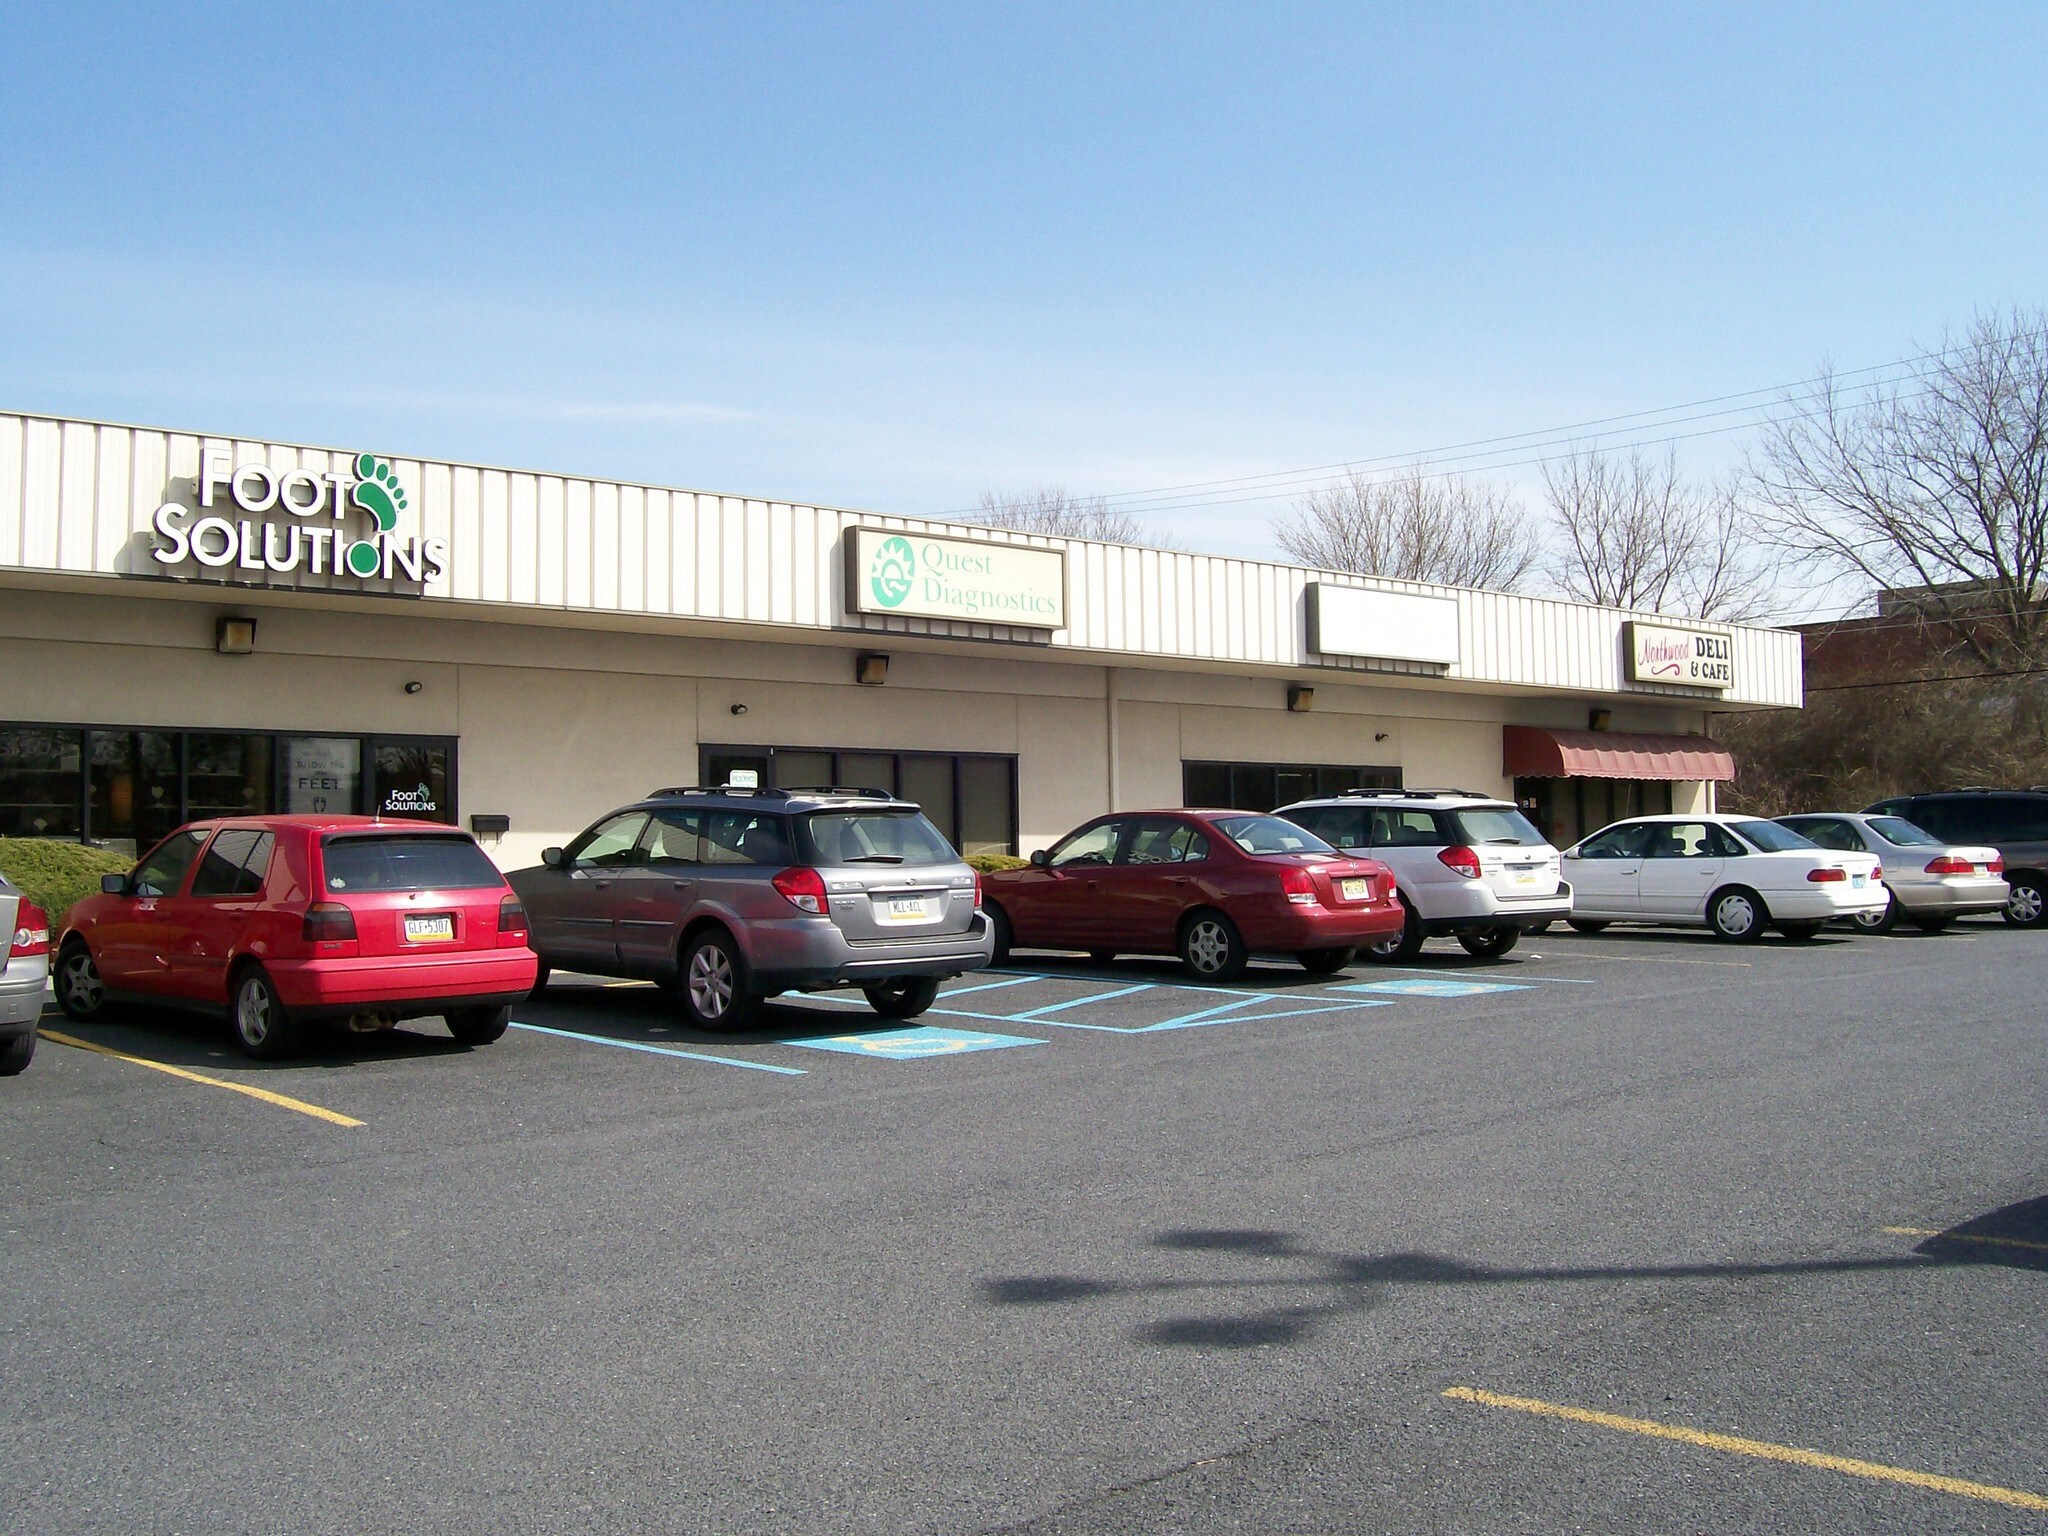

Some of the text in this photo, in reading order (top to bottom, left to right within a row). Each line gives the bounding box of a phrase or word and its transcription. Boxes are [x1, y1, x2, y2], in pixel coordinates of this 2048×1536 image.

[200, 447, 355, 520] FOOT
[152, 502, 450, 584] SOLUTIONS
[921, 542, 993, 577] Quest
[923, 577, 1057, 616] Diagnostics
[1637, 634, 1690, 666] Northwood
[1695, 636, 1729, 660] DELI
[1690, 660, 1730, 681] & CAFE
[298, 777, 338, 790] FEET
[391, 789, 418, 801] FOOT
[385, 799, 437, 811] SOLUTIONS
